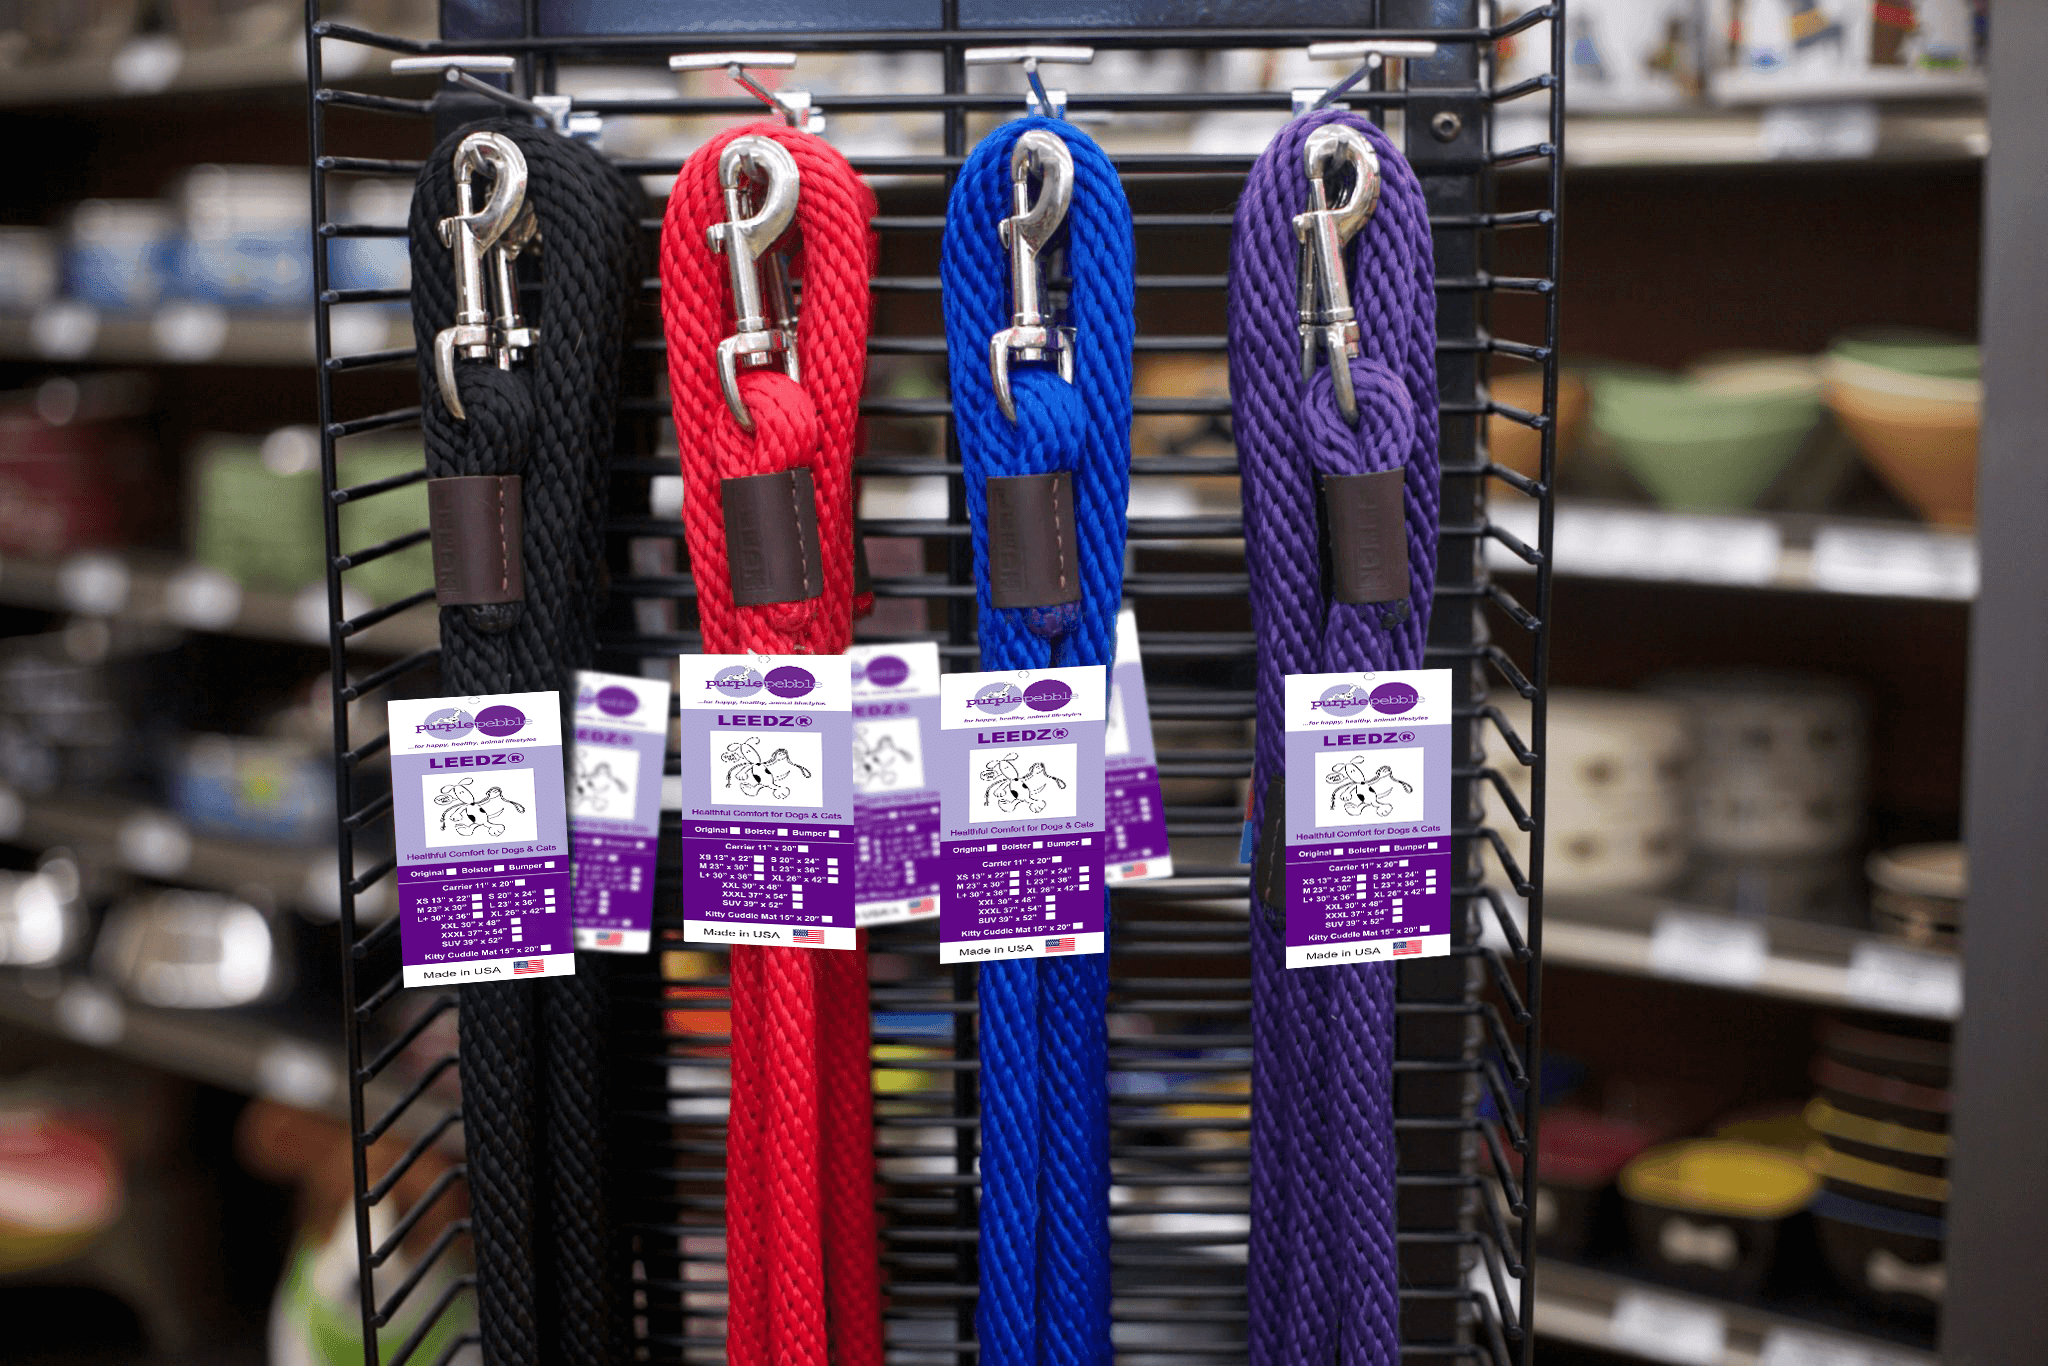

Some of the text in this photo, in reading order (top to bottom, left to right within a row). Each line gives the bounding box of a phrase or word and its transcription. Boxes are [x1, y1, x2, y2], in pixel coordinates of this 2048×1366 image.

[717, 713, 813, 727] LEEDZ®
[977, 727, 1068, 744] LEEDZ®
[1322, 731, 1415, 746] LEEDZ®
[429, 752, 525, 769] LEEDZ®
[691, 807, 842, 820] Healthful Comfort for Dogs & Cats
[694, 825, 827, 838] Original Bolster Bumper
[950, 820, 1094, 837] Healthful Comfort for Dogs & Cats
[1295, 823, 1441, 840] Healthful Comfort for Dogs & Cats
[406, 843, 557, 861] Healthful Comfort for Dogs & Cats
[952, 838, 1079, 855] Original Bolster Bumper
[1298, 842, 1426, 858] Original Bolster Bumper
[410, 862, 543, 879] Original Bolster Bumper
[703, 927, 780, 939] Made in USA
[959, 943, 1033, 956] Made in USA
[1305, 946, 1380, 960] Made in USA
[423, 965, 501, 979] Made in USA
